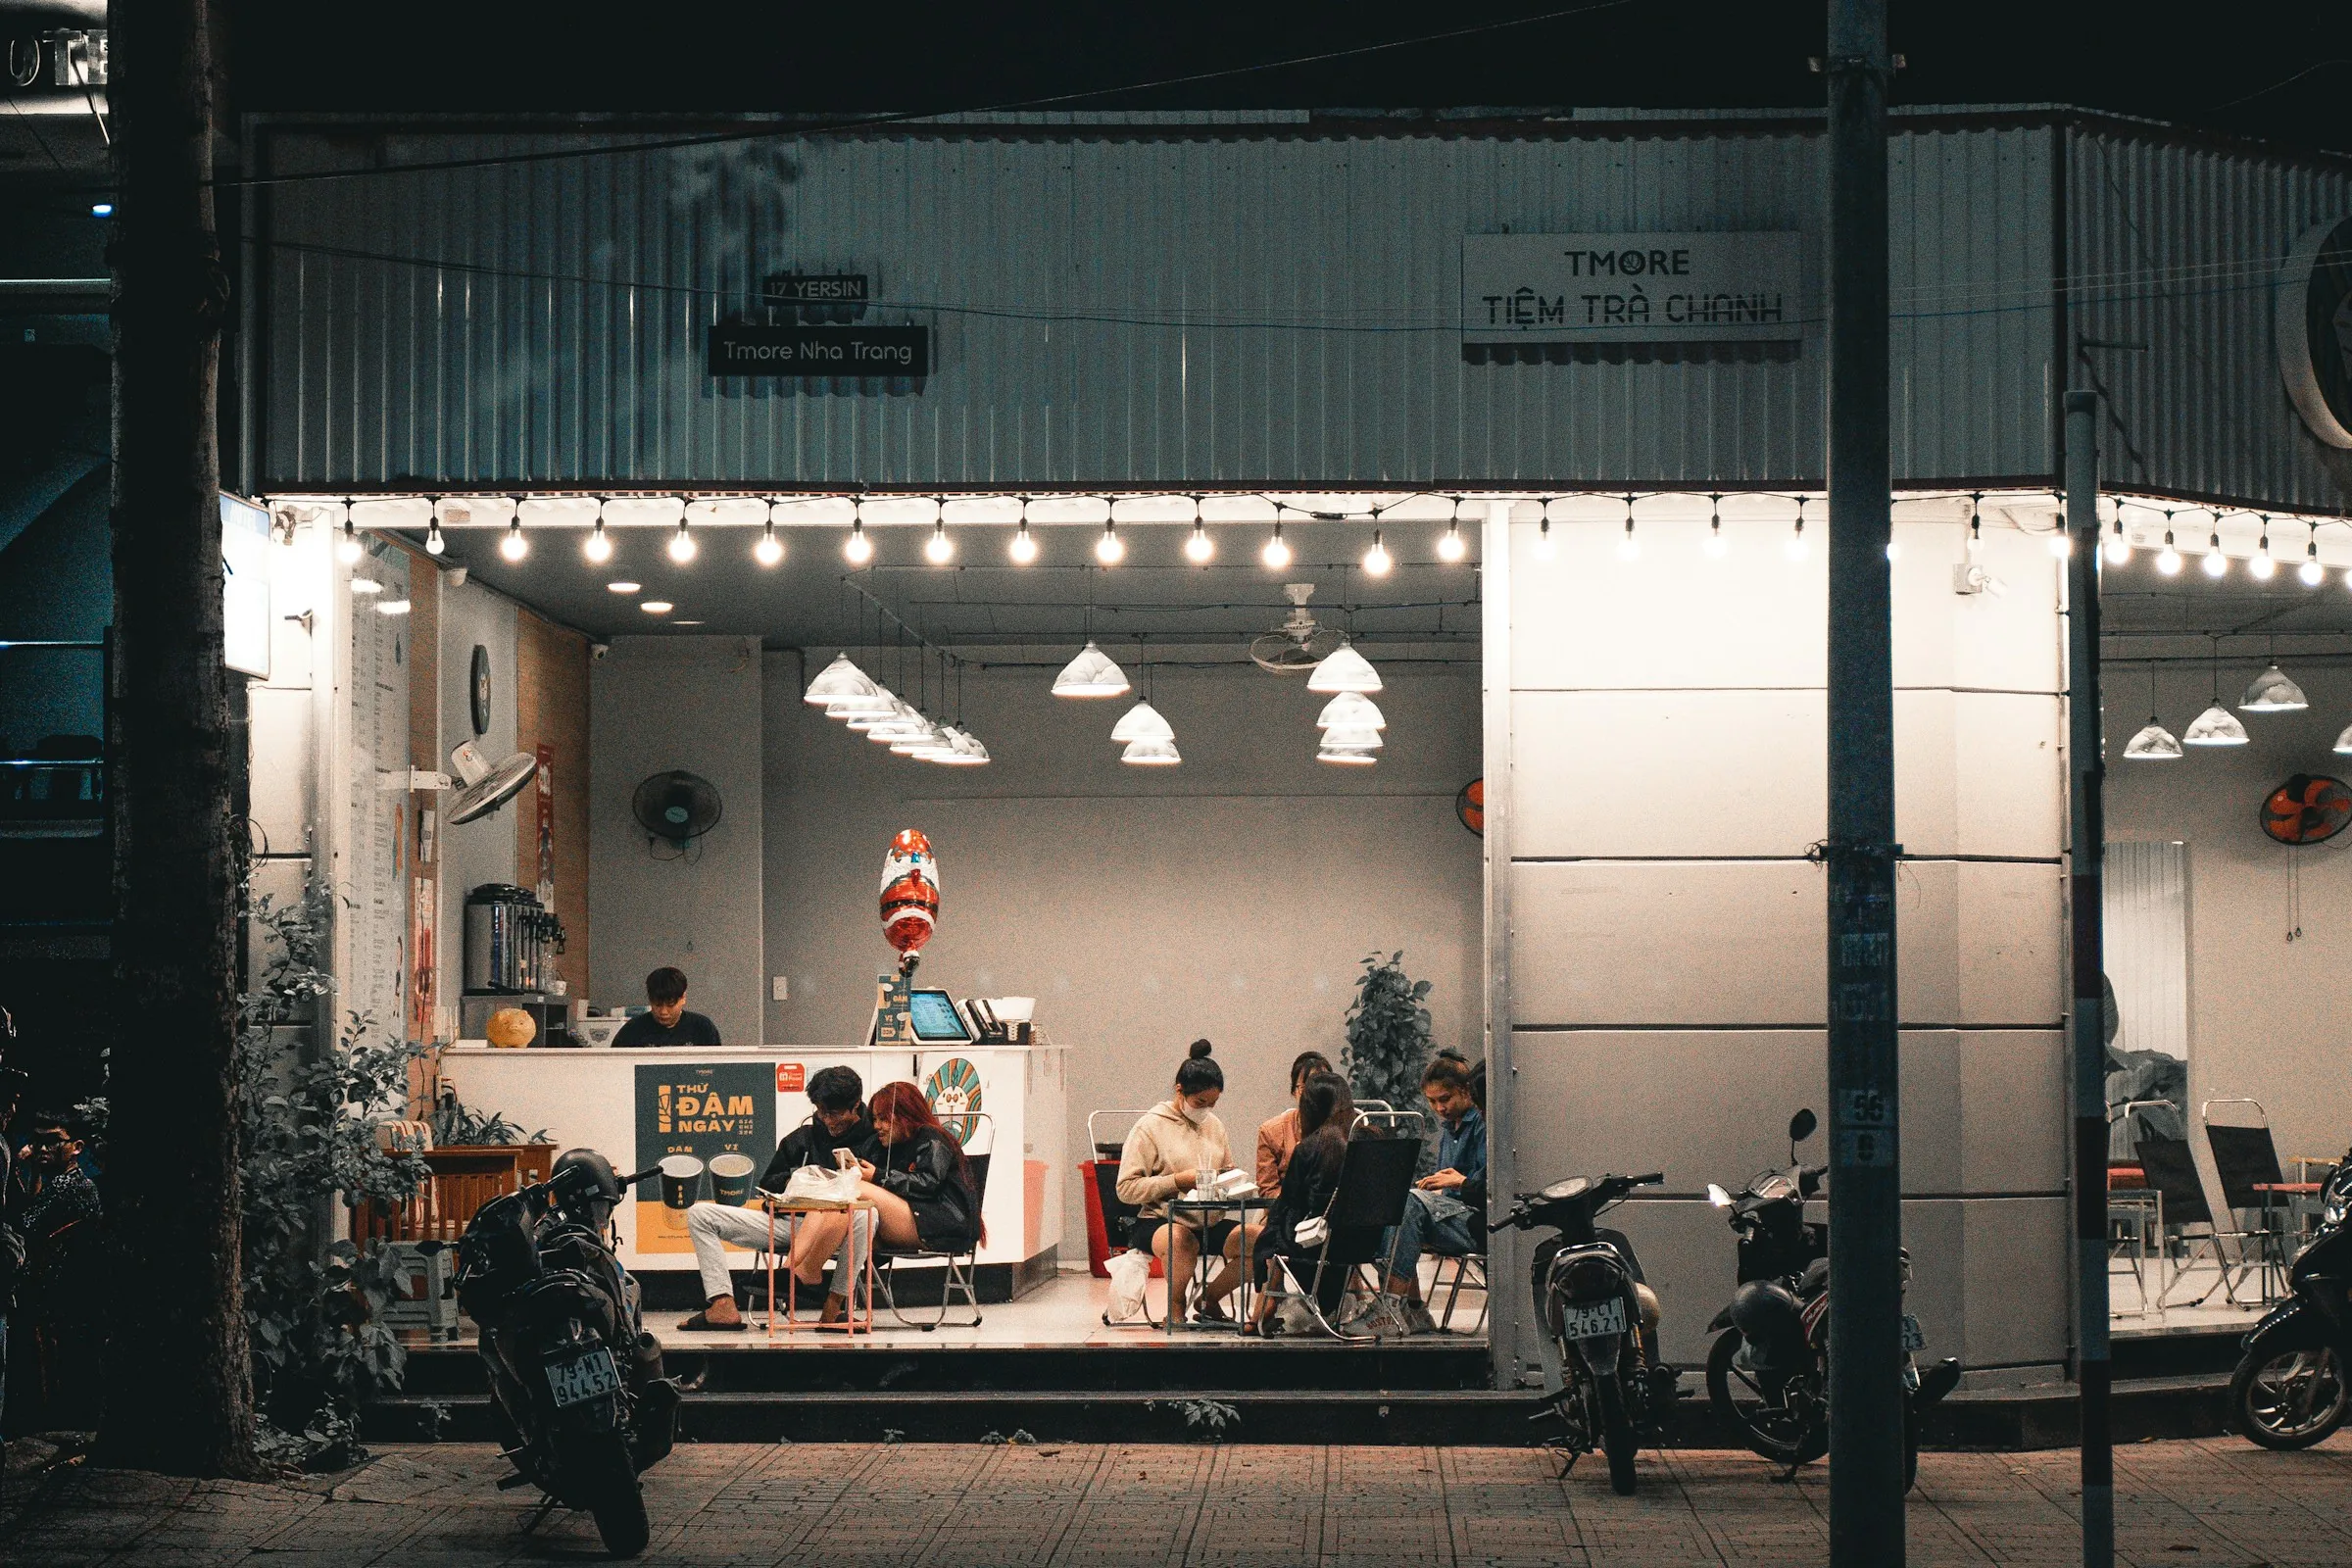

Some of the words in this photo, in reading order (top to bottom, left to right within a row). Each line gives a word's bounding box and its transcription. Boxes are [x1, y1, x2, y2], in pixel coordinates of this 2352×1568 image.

[1564, 249, 1690, 276] TMORE
[769, 281, 787, 296] 17
[794, 280, 862, 298] YERSIN
[1482, 286, 1564, 331] TIỆM
[1581, 283, 1650, 323] TRÀ
[1666, 293, 1783, 324] CHANH
[723, 341, 793, 361] Tmore
[800, 341, 843, 361] Nha
[851, 341, 912, 365] Trang
[557, 1371, 616, 1404] 944.52
